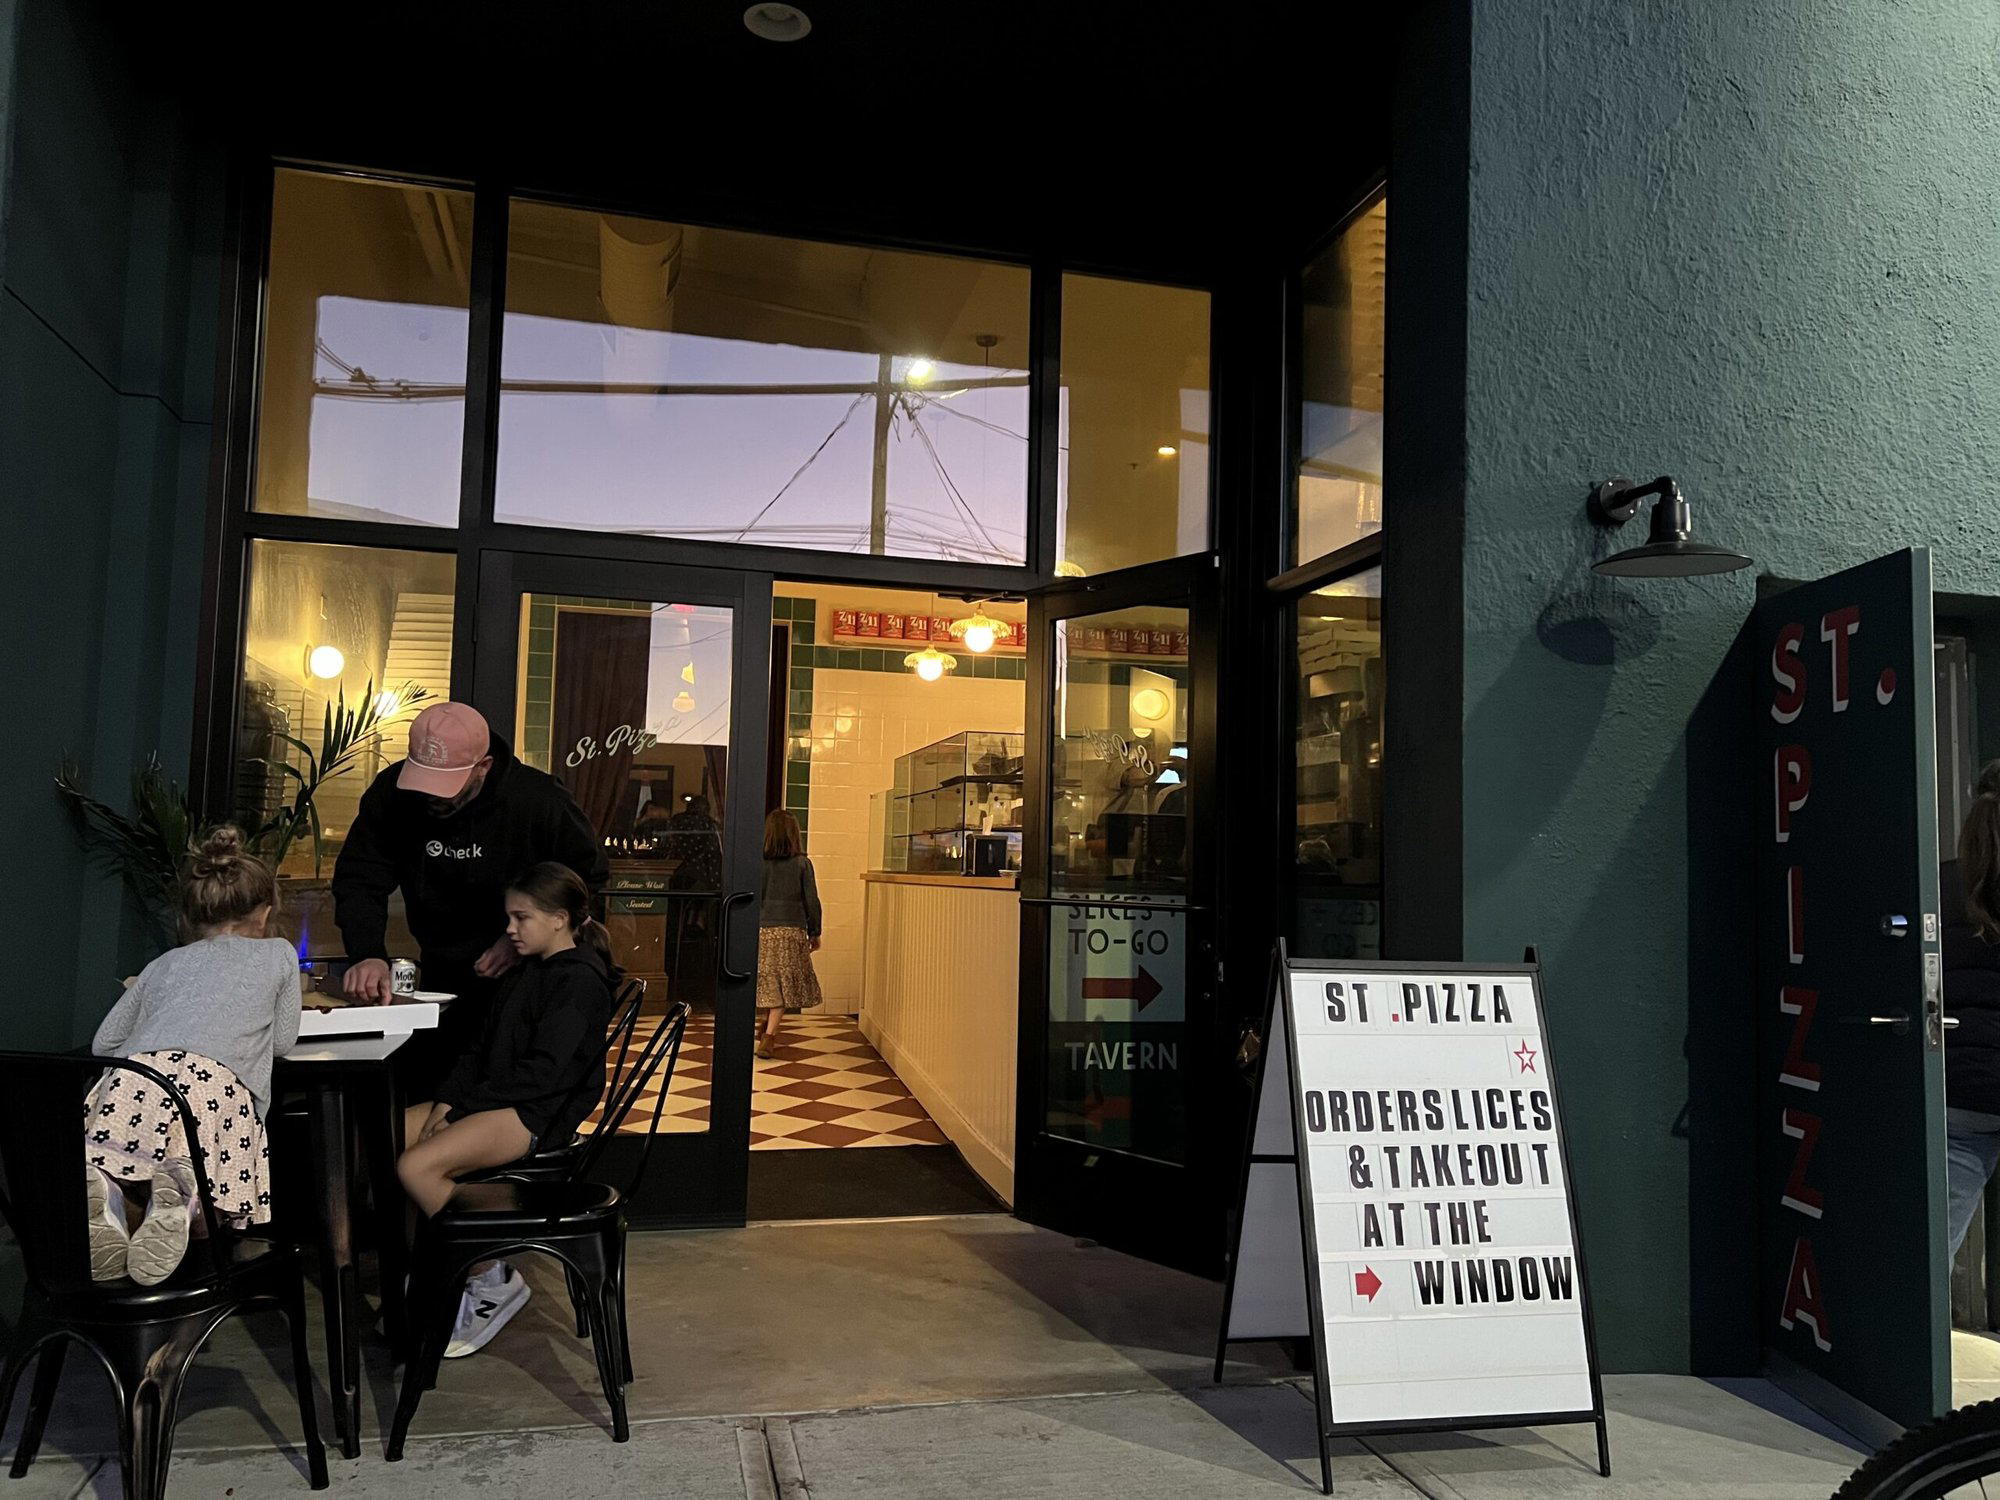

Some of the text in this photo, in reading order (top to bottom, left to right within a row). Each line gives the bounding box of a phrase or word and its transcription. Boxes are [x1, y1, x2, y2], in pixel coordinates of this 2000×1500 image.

[1771, 607, 1896, 725] ST.
[1068, 929, 1169, 955] TO-GO
[1064, 1041, 1178, 1071] TAVERN
[1773, 743, 1832, 1354] PIZZA
[1349, 1142, 1550, 1189] & TAKEOUT
[1363, 1199, 1492, 1247] AT THE
[1414, 1256, 1573, 1305] WINDOW
